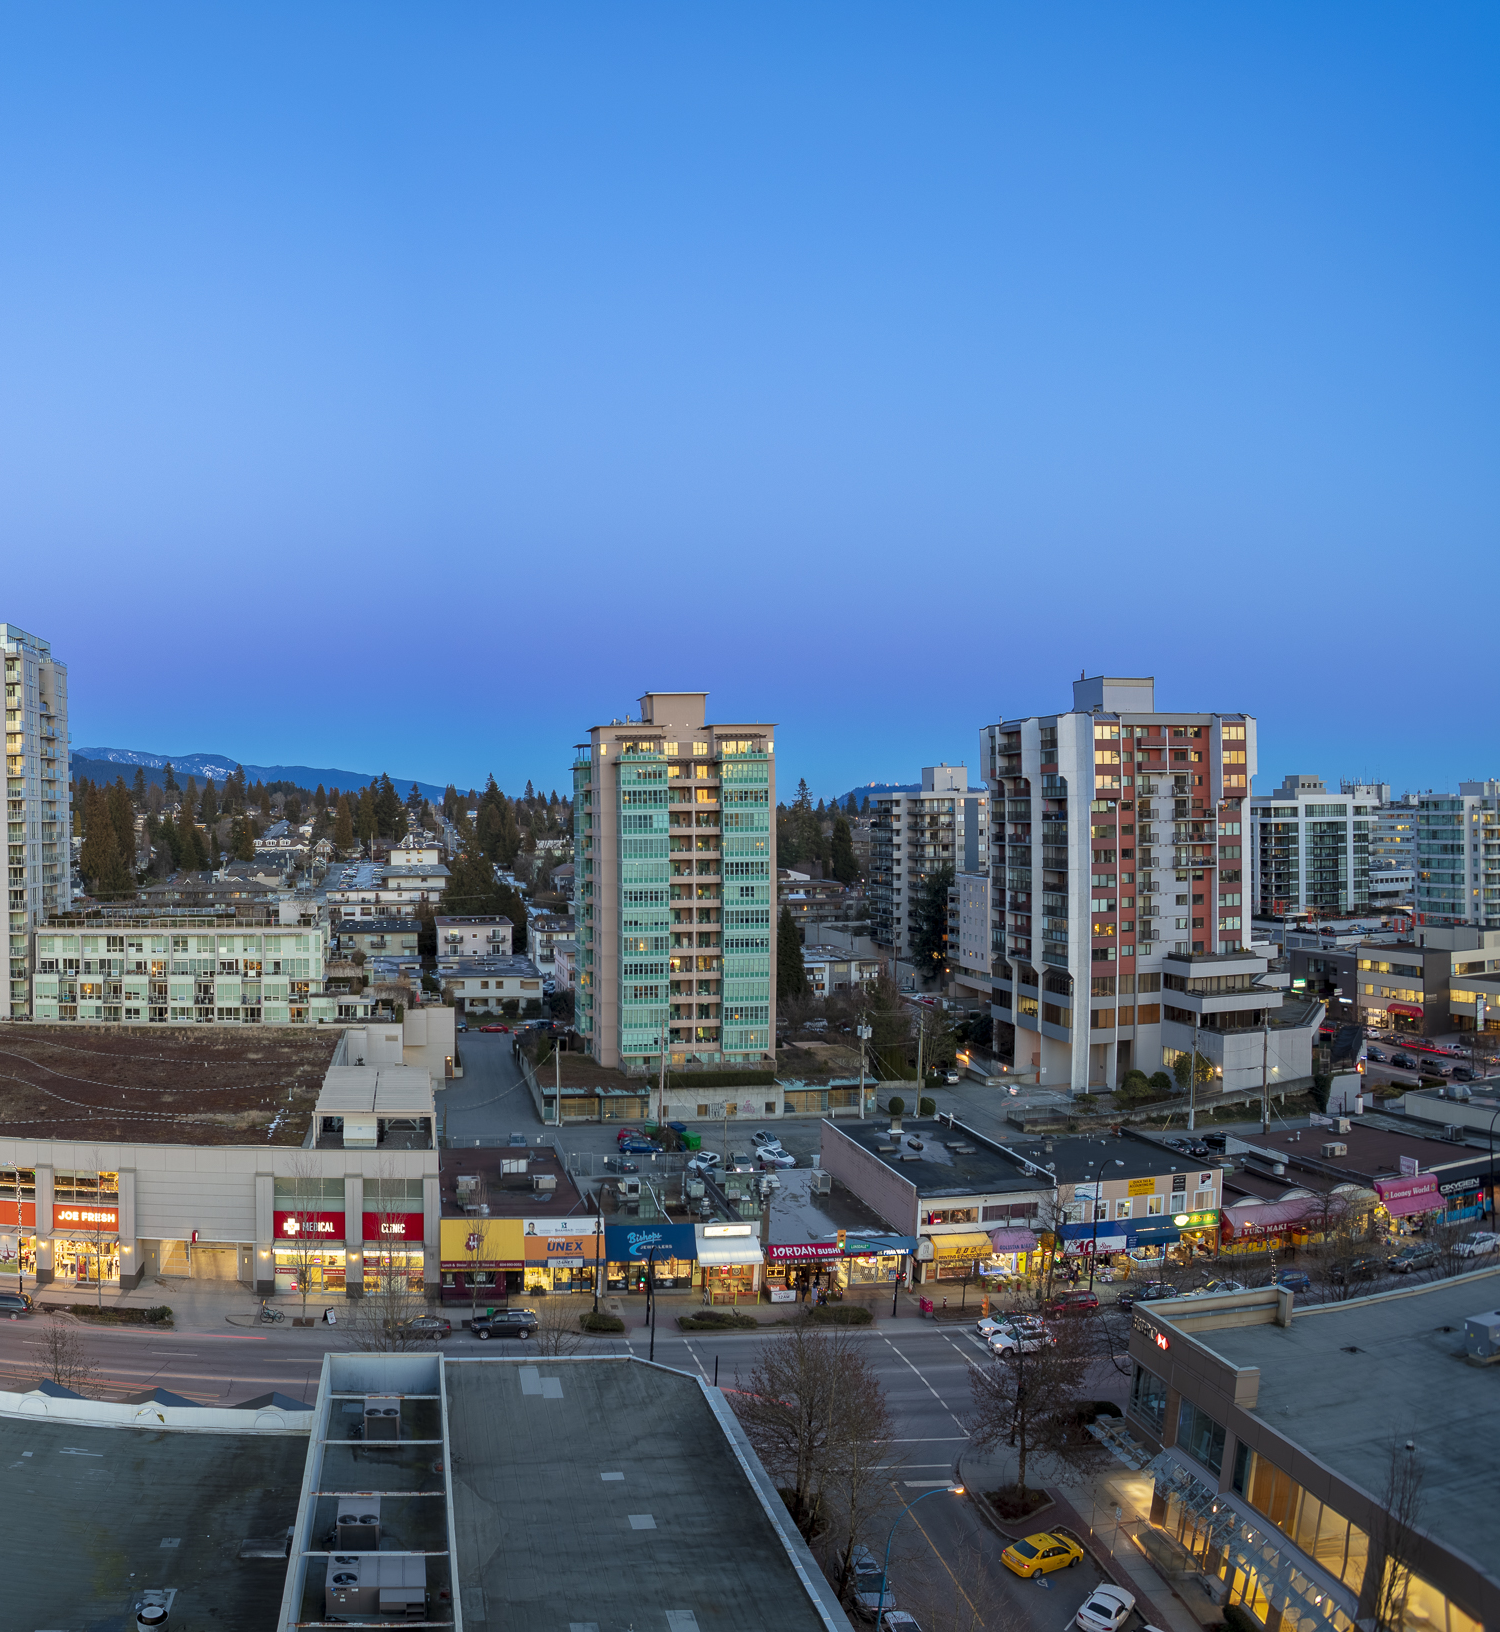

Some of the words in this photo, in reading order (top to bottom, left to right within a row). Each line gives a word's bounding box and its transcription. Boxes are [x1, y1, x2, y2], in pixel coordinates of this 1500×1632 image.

[1440, 1177, 1480, 1192] OXYGEN
[1390, 1189, 1412, 1199] Looney
[1412, 1185, 1430, 1194] World
[57, 1210, 80, 1222] JOE
[81, 1211, 116, 1223] FRESH
[302, 1221, 336, 1233] MEDICAL
[381, 1222, 406, 1234] CLINIC
[1266, 1223, 1287, 1233] MAKI
[627, 1230, 662, 1244] Bishops
[547, 1241, 584, 1252] UNEX
[772, 1245, 817, 1258] JORDAN
[817, 1247, 841, 1255] SUSHI
